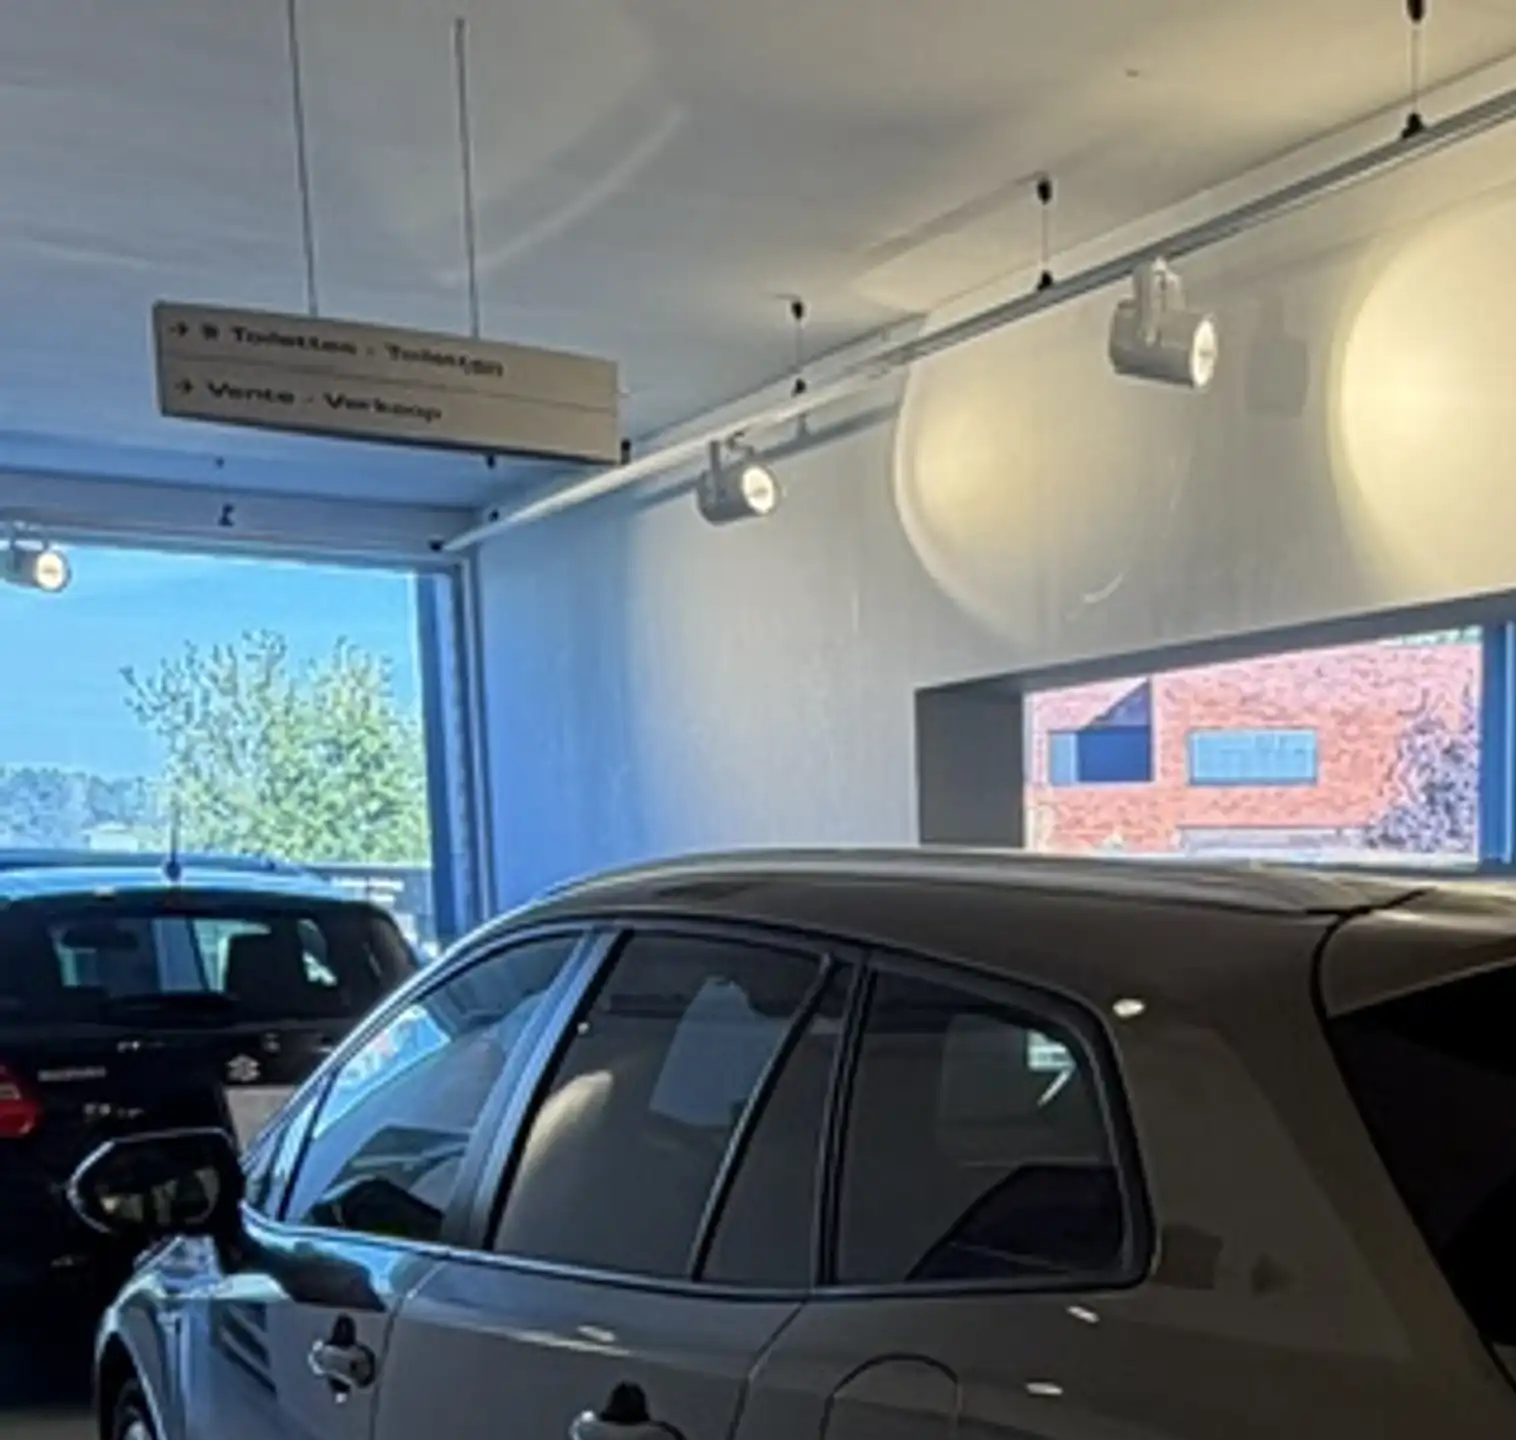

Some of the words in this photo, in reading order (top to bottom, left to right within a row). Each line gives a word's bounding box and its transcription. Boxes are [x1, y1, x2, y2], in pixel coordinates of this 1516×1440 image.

[232, 326, 357, 356] Toilettes
[207, 378, 296, 405] Vente
[323, 393, 443, 424] Verkoop
